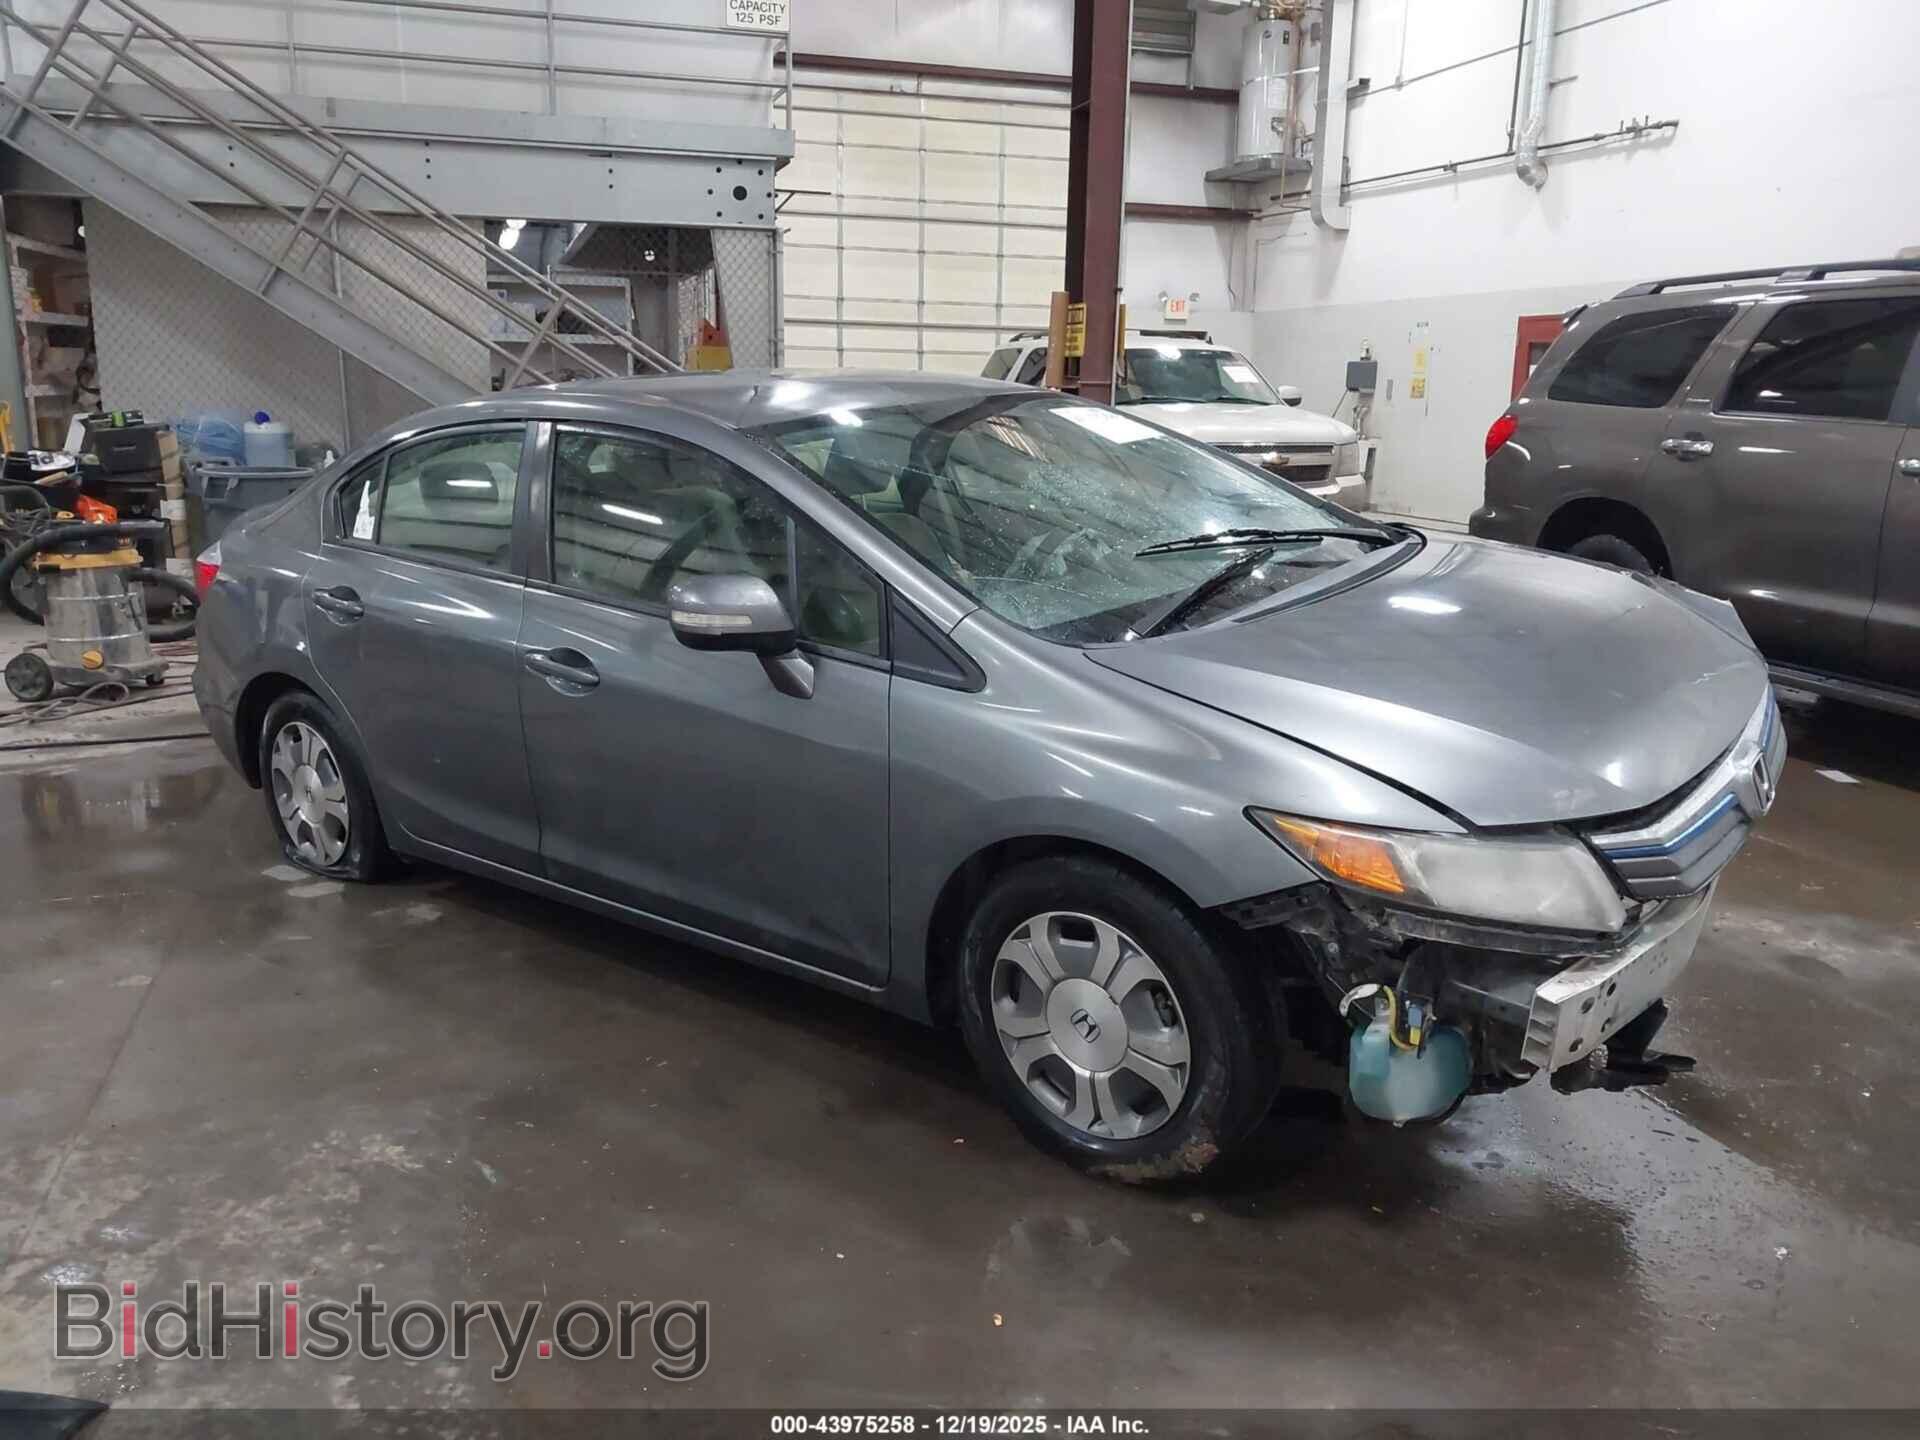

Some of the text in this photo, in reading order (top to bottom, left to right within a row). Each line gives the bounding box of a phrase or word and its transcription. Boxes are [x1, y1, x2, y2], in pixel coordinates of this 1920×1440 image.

[730, 0, 785, 13] CAPACITY
[736, 12, 781, 25] 125 PSF
[1169, 298, 1185, 313] EXIT
